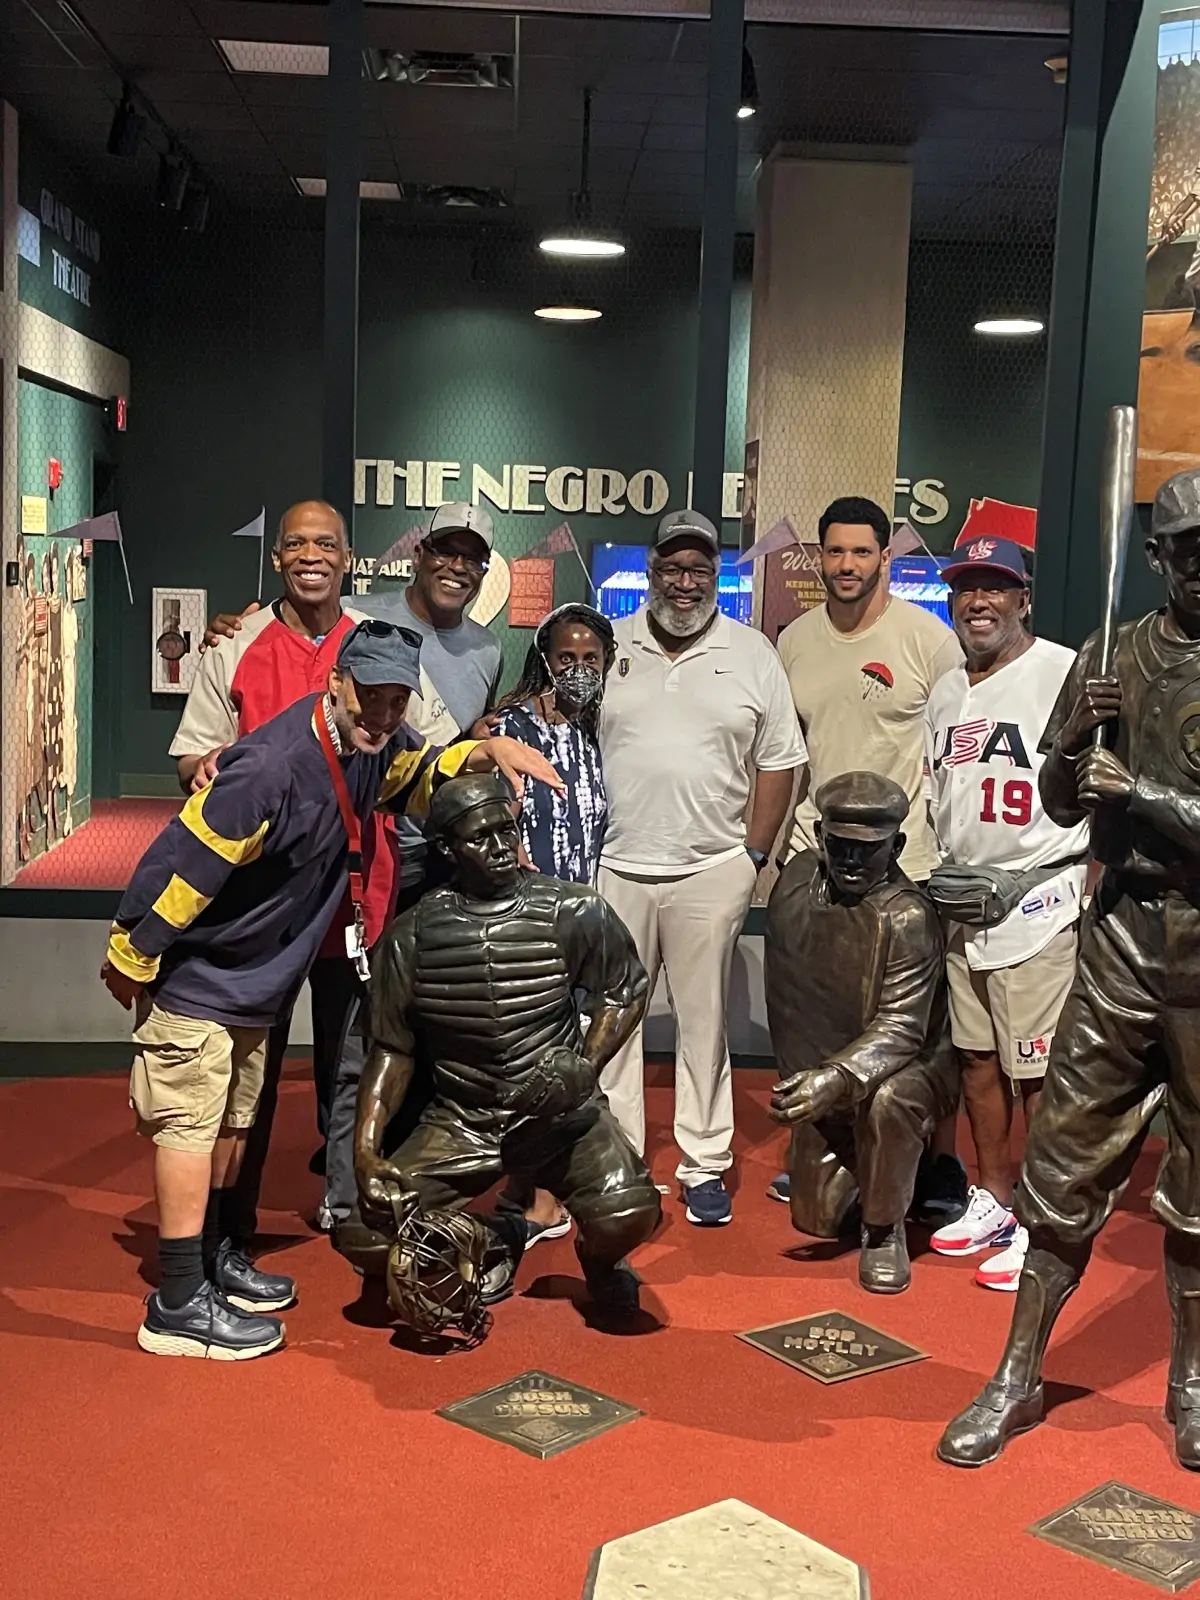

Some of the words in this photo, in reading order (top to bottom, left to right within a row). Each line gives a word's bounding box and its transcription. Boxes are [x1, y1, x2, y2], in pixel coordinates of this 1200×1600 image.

[52, 248, 92, 308] THEATRE
[354, 458, 461, 508] THE
[472, 463, 670, 516] NEGRO
[378, 559, 413, 577] ARE
[933, 718, 1033, 770] USA
[979, 777, 1033, 826] 19
[809, 1326, 856, 1342] BOB
[783, 1336, 880, 1357] MOTLEY
[505, 1391, 573, 1403] JOSH
[493, 1402, 591, 1417] GIBSON
[1075, 1507, 1195, 1526] MARTIN
